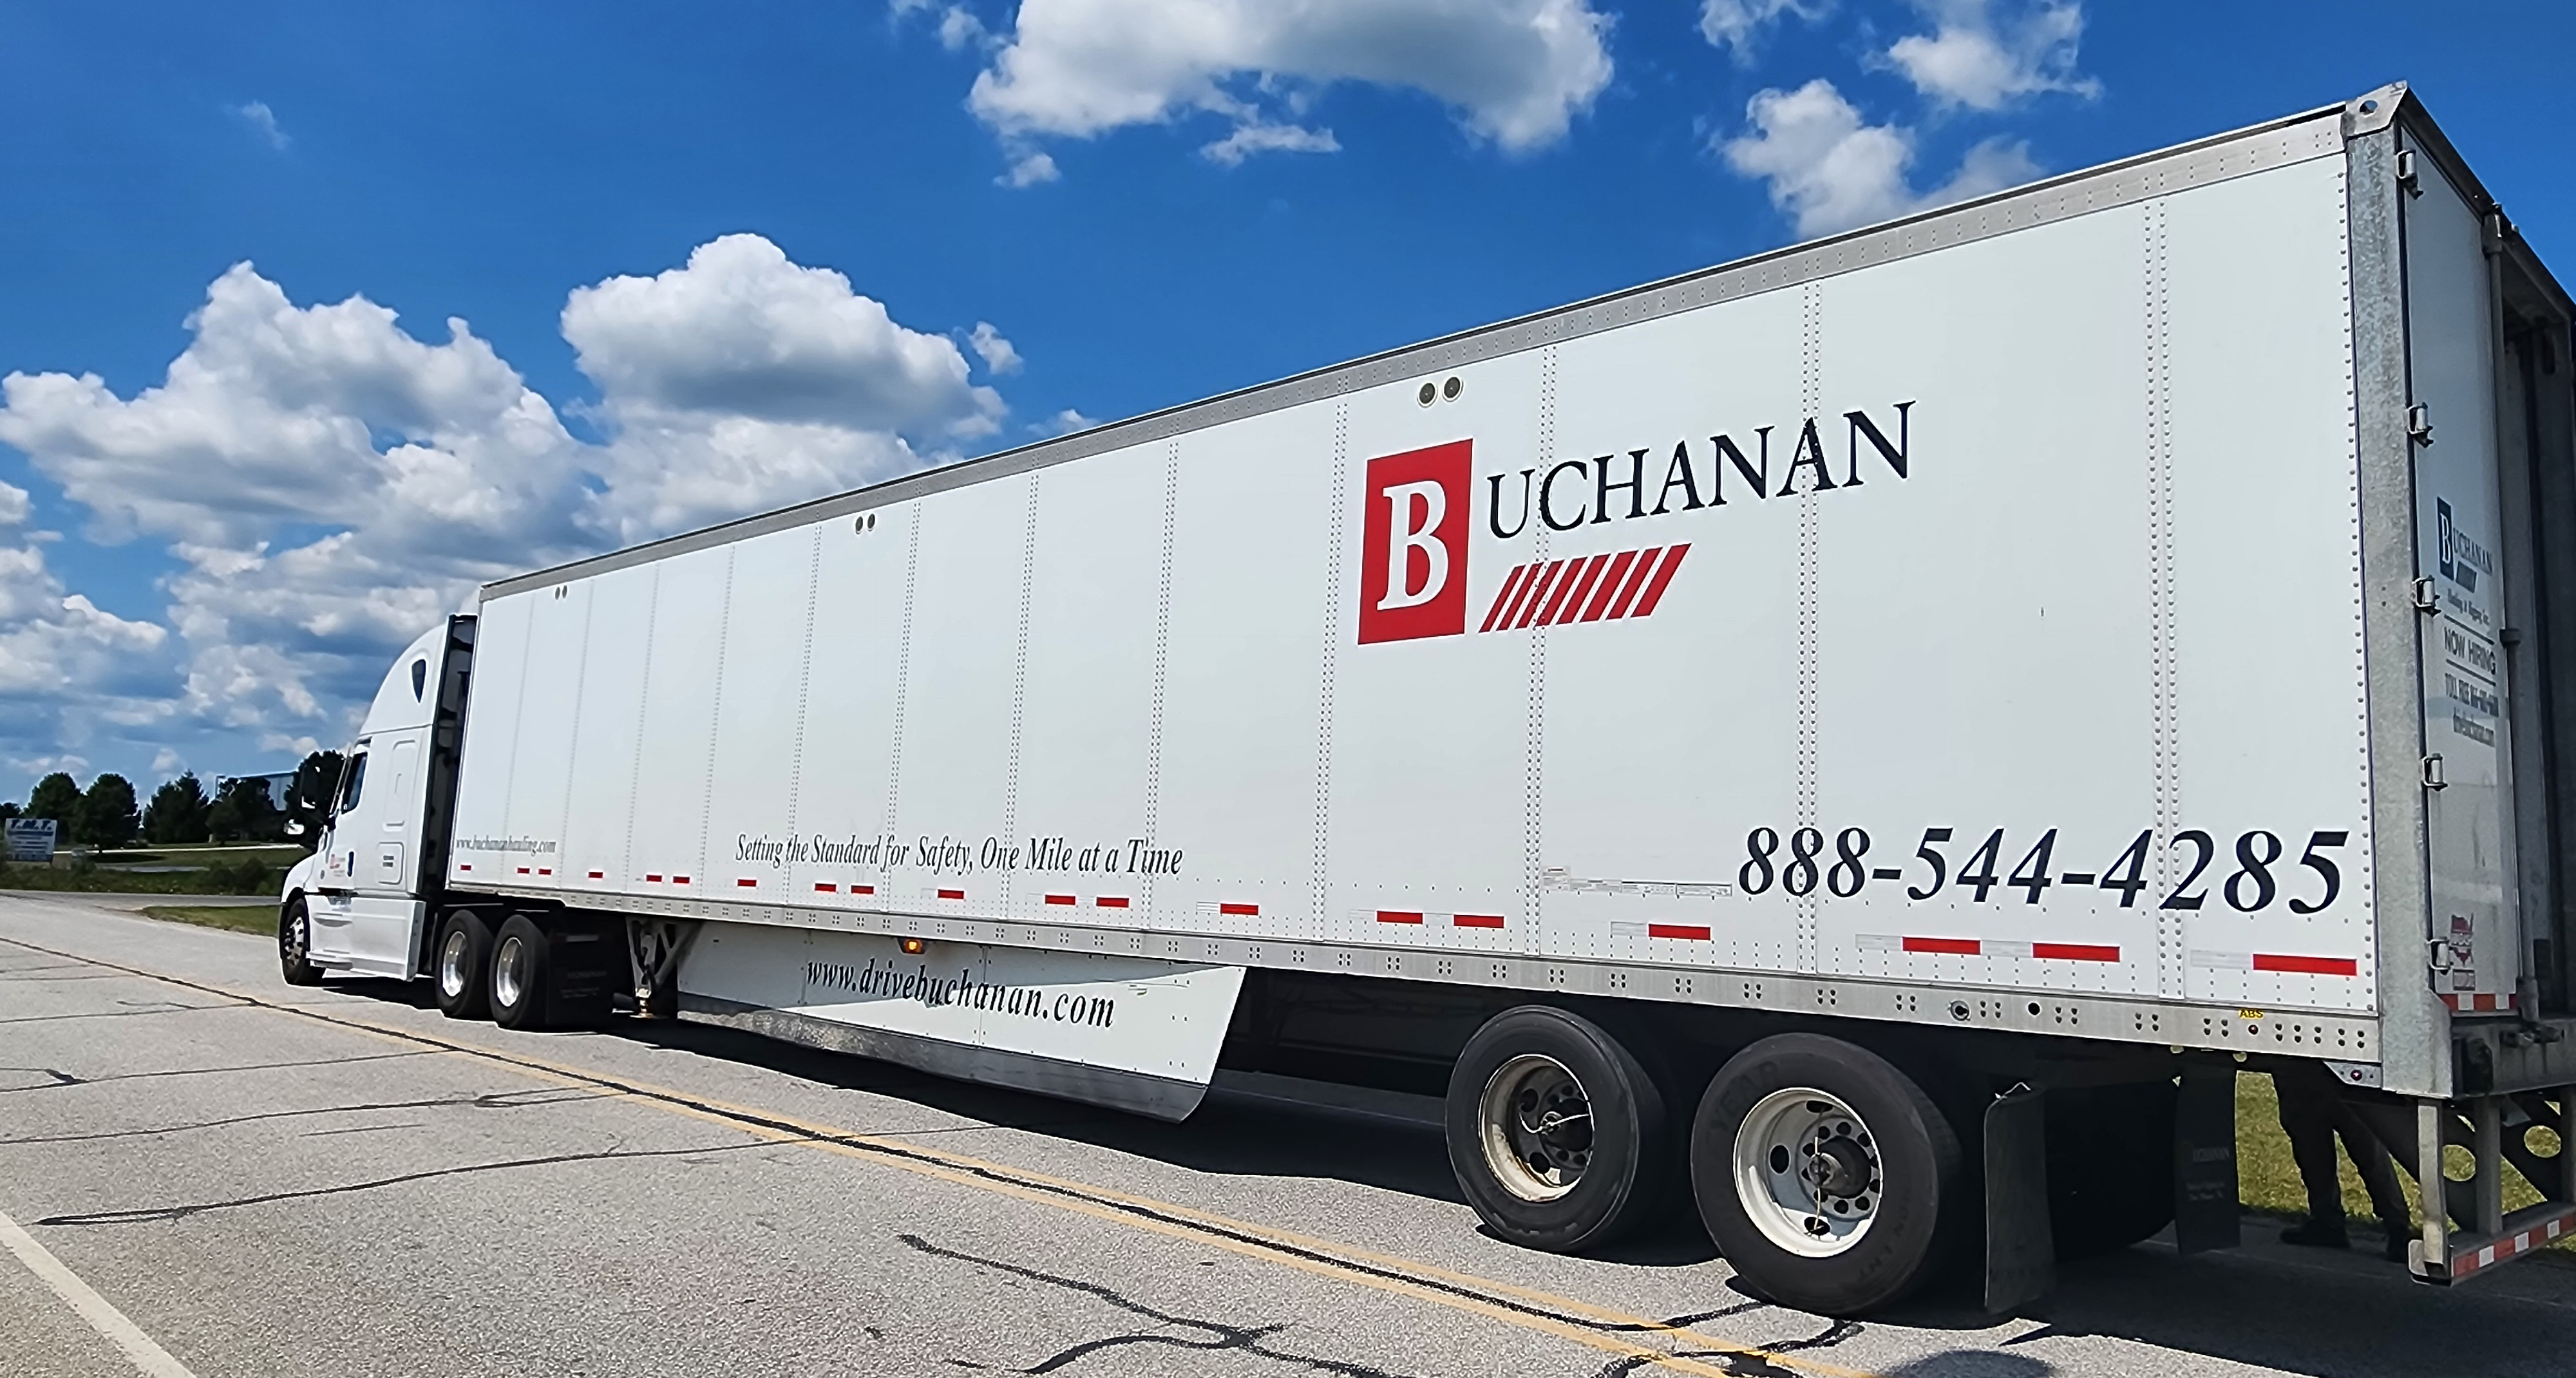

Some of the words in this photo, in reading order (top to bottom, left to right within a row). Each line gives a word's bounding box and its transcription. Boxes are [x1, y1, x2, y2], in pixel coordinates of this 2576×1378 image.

[2444, 627, 2465, 658] NOW
[735, 834, 783, 869] Setting
[785, 835, 809, 862] the
[811, 834, 882, 865] Standard
[880, 835, 909, 872] for
[916, 835, 972, 876] Safety,
[981, 836, 1019, 870] One
[1025, 837, 1072, 871] Mile
[1078, 842, 1101, 872] at
[1105, 848, 1119, 873] a
[1126, 839, 1183, 874] Time
[1738, 827, 2349, 914] 888-544-4285
[806, 958, 1114, 1028] www.drivebuchanan.com
[2239, 1009, 2264, 1018] ABS
